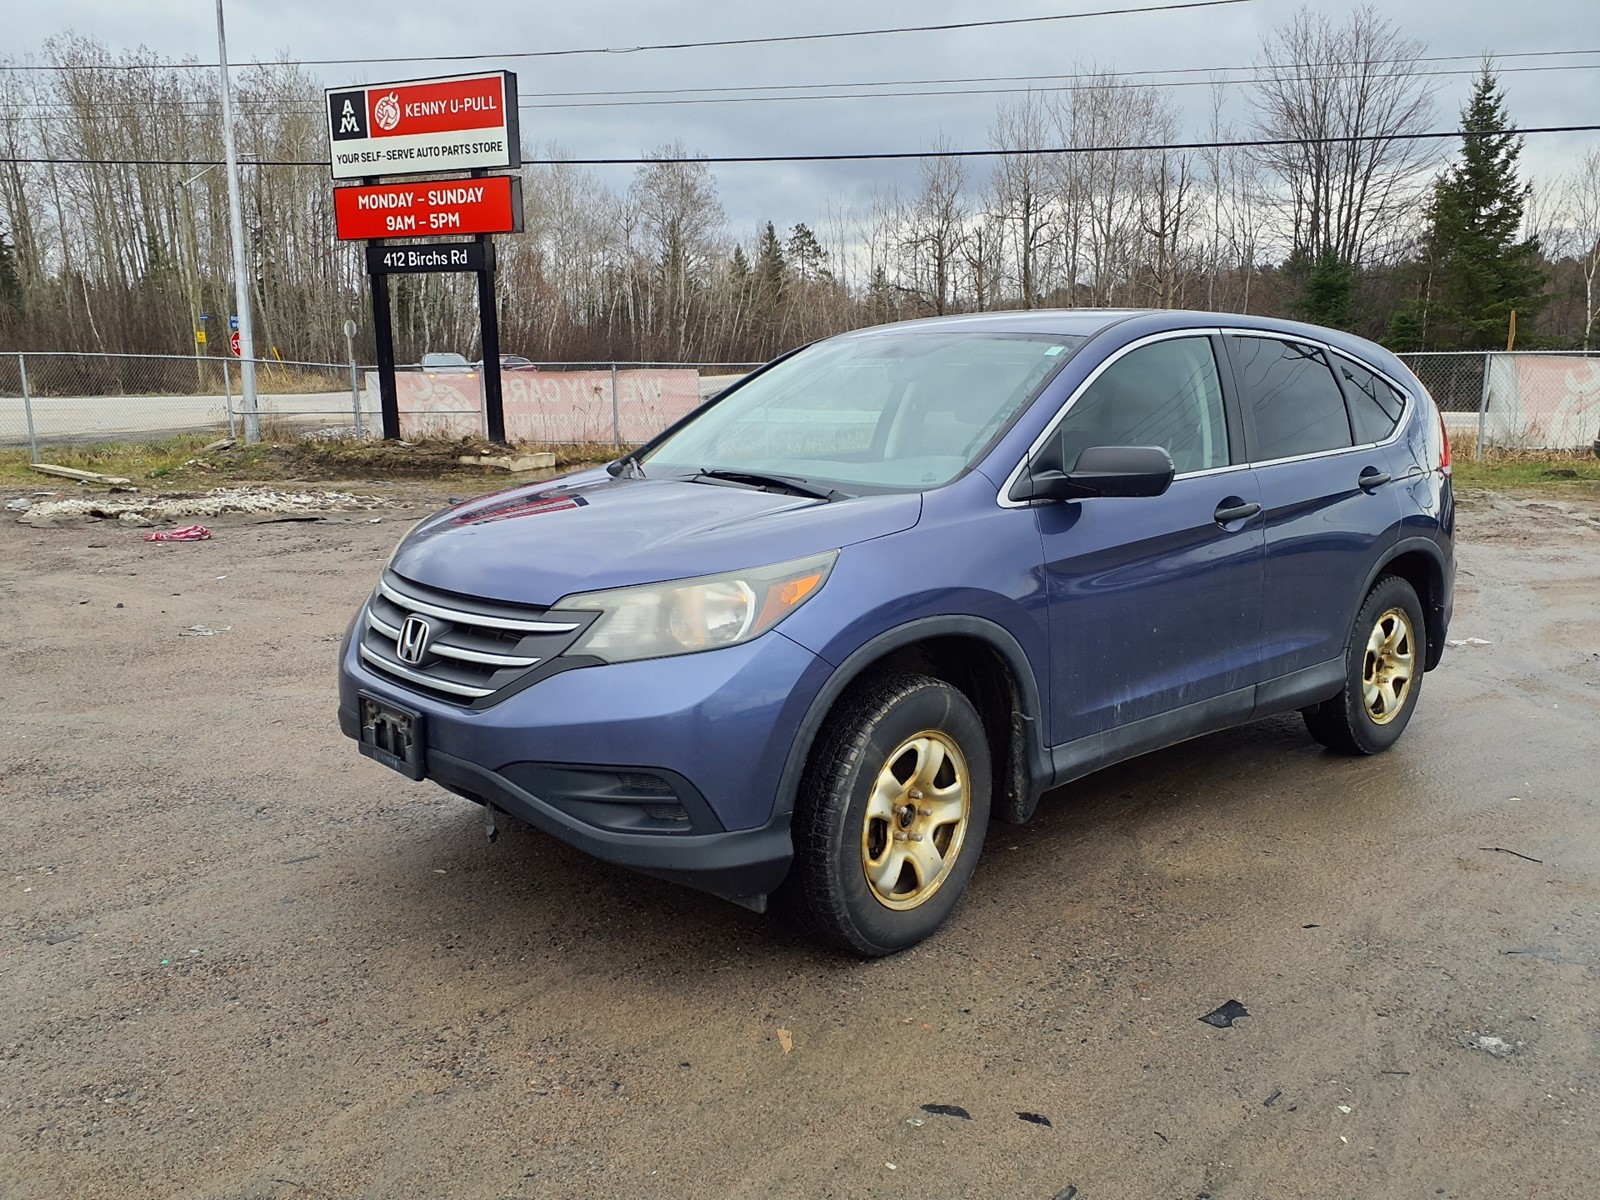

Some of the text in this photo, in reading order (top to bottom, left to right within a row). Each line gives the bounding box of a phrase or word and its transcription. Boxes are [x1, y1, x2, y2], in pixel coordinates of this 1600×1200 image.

[405, 95, 497, 117] KENNY U-PULL
[336, 141, 503, 165] YOUR SELF-SERVE AUTO PARTS STORE
[358, 192, 414, 210] MONDAY
[427, 187, 484, 206] SUNDAY
[386, 214, 416, 231] 9AM
[429, 212, 460, 229] 5PM
[383, 249, 468, 267] 412 Birchs Rd
